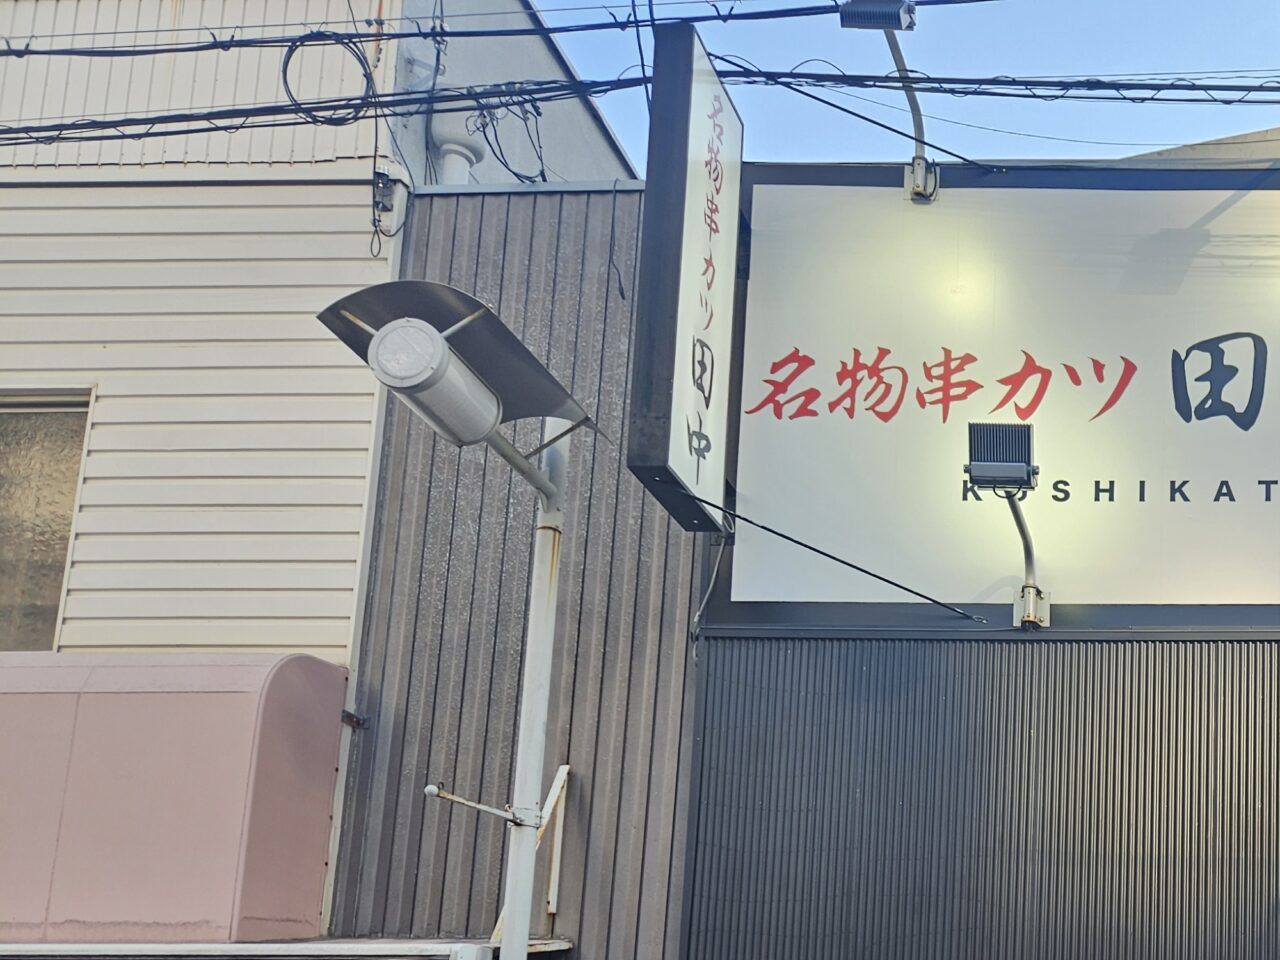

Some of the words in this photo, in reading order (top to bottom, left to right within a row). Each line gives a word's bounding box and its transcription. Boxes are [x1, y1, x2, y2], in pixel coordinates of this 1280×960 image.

[700, 94, 725, 331] 名物串カツ
[685, 335, 715, 486] 田中
[744, 346, 1138, 425] 名物串カツ
